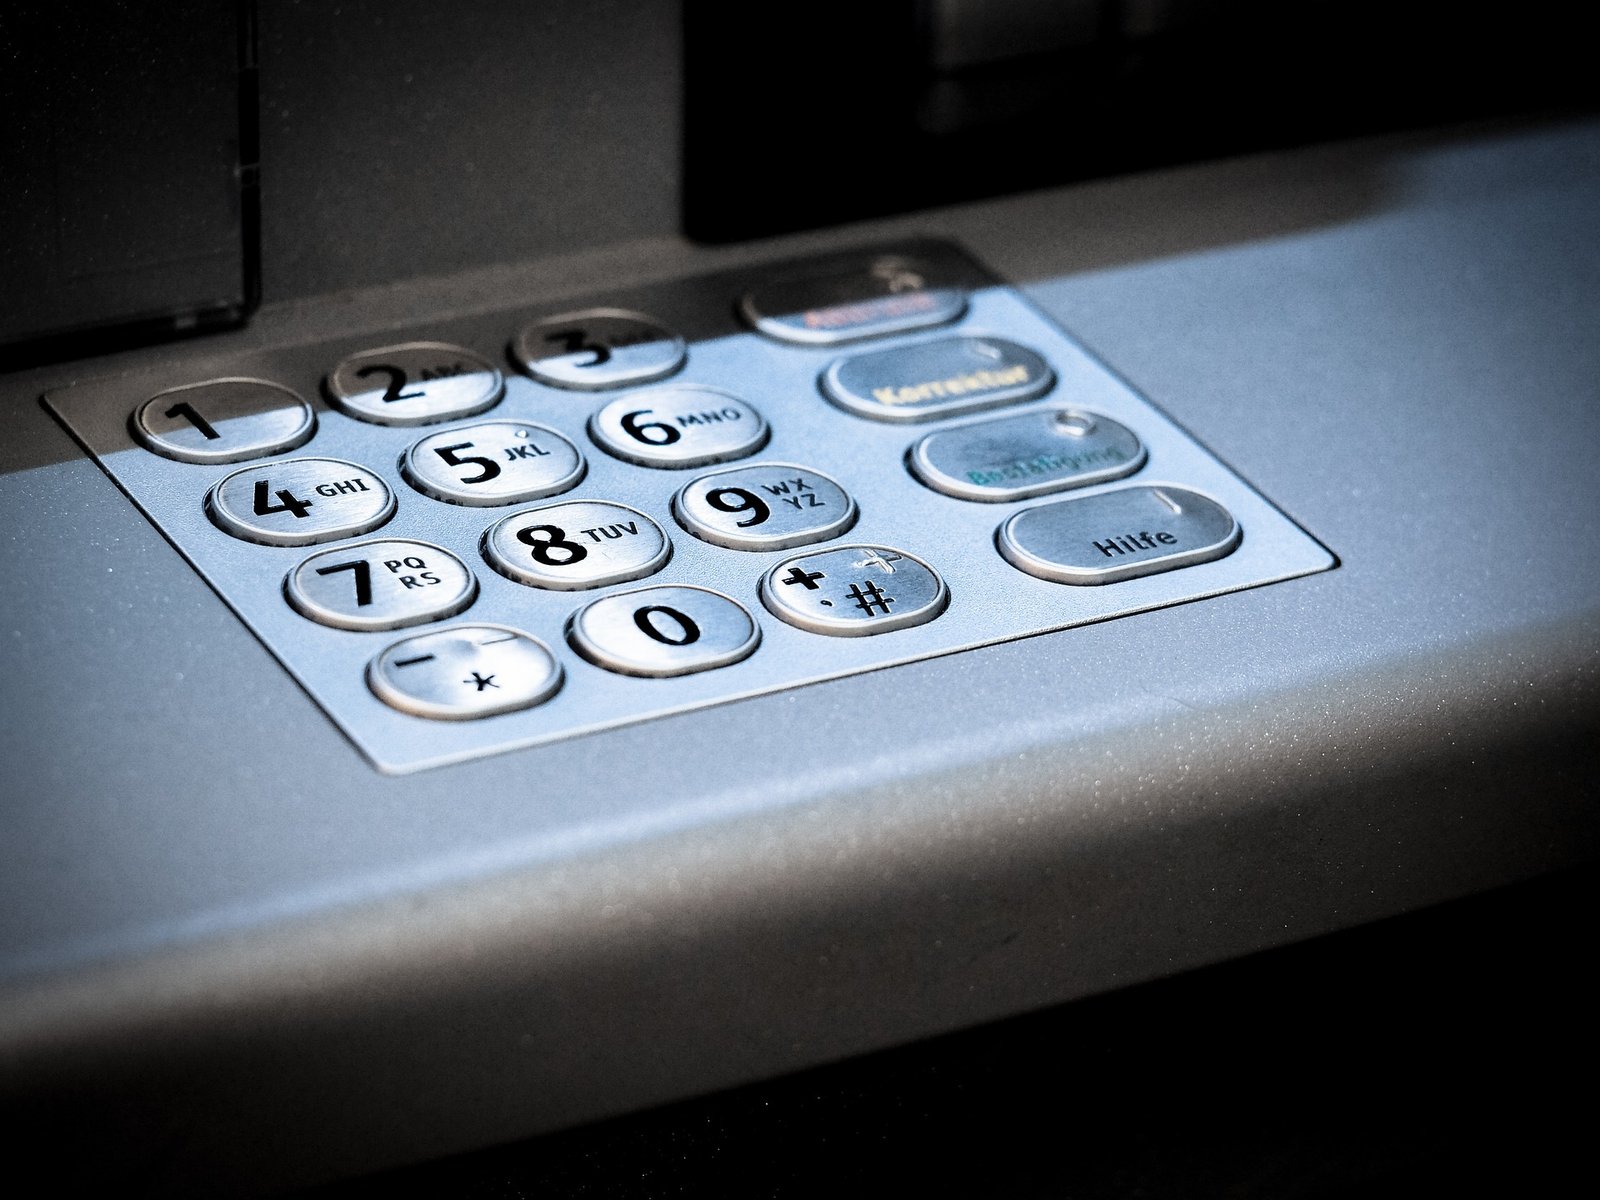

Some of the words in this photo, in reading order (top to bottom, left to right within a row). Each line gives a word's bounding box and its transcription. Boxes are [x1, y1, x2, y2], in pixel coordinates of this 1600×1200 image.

[544, 330, 611, 368] 3
[356, 364, 426, 403] 2
[164, 401, 222, 441] 1
[620, 409, 681, 447] 6
[677, 408, 742, 428] MNO
[433, 441, 502, 485] 5
[504, 442, 551, 462] JKL
[252, 480, 313, 519] 4
[315, 477, 371, 498] GHI
[705, 487, 771, 528] 9
[761, 477, 815, 497] WX
[782, 493, 826, 511] YZ
[516, 524, 588, 567] 8
[581, 520, 639, 542] TUV
[1093, 529, 1178, 558] Hilfe
[315, 559, 373, 607] 7
[383, 556, 427, 574] PQ
[398, 571, 442, 590] RS
[633, 604, 701, 646] 0
